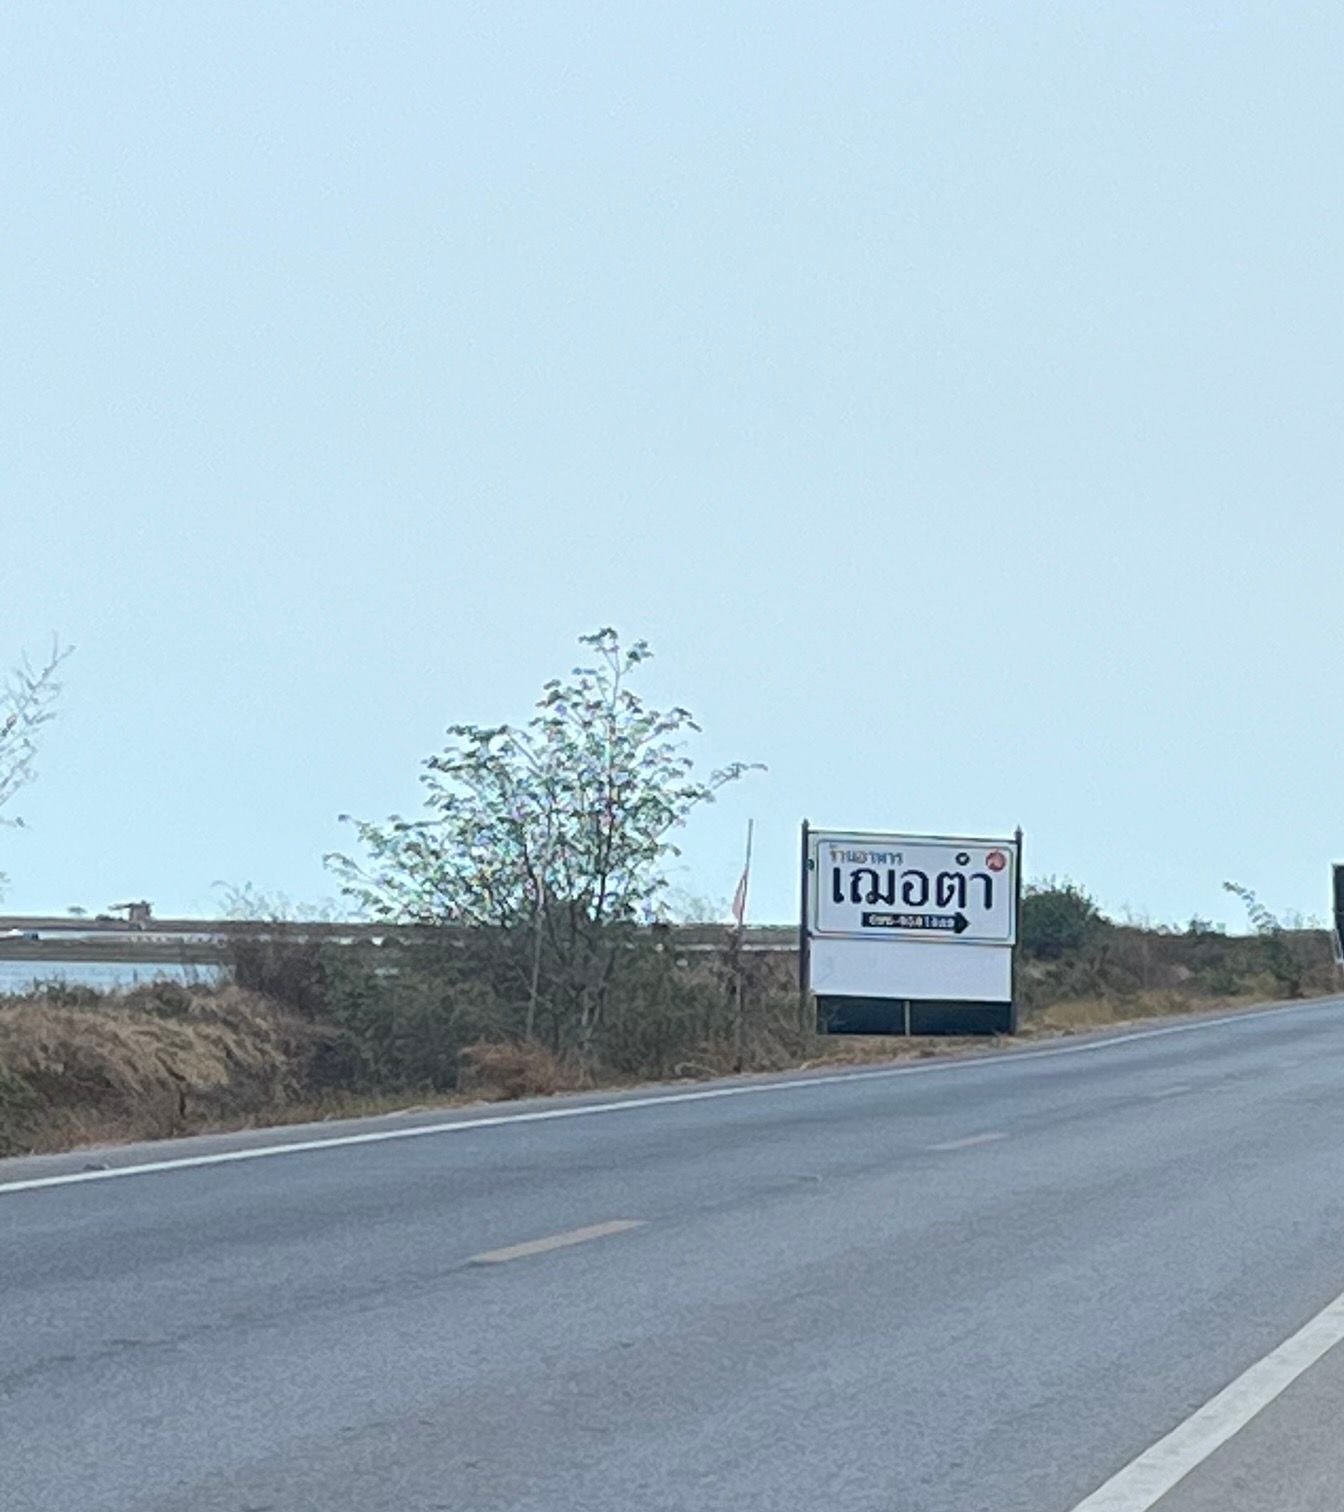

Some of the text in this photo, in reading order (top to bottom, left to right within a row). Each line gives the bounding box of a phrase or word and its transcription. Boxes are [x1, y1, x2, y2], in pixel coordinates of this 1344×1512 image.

[829, 843, 903, 865] ร้านอาหาร
[833, 852, 993, 910] เฌอตำ
